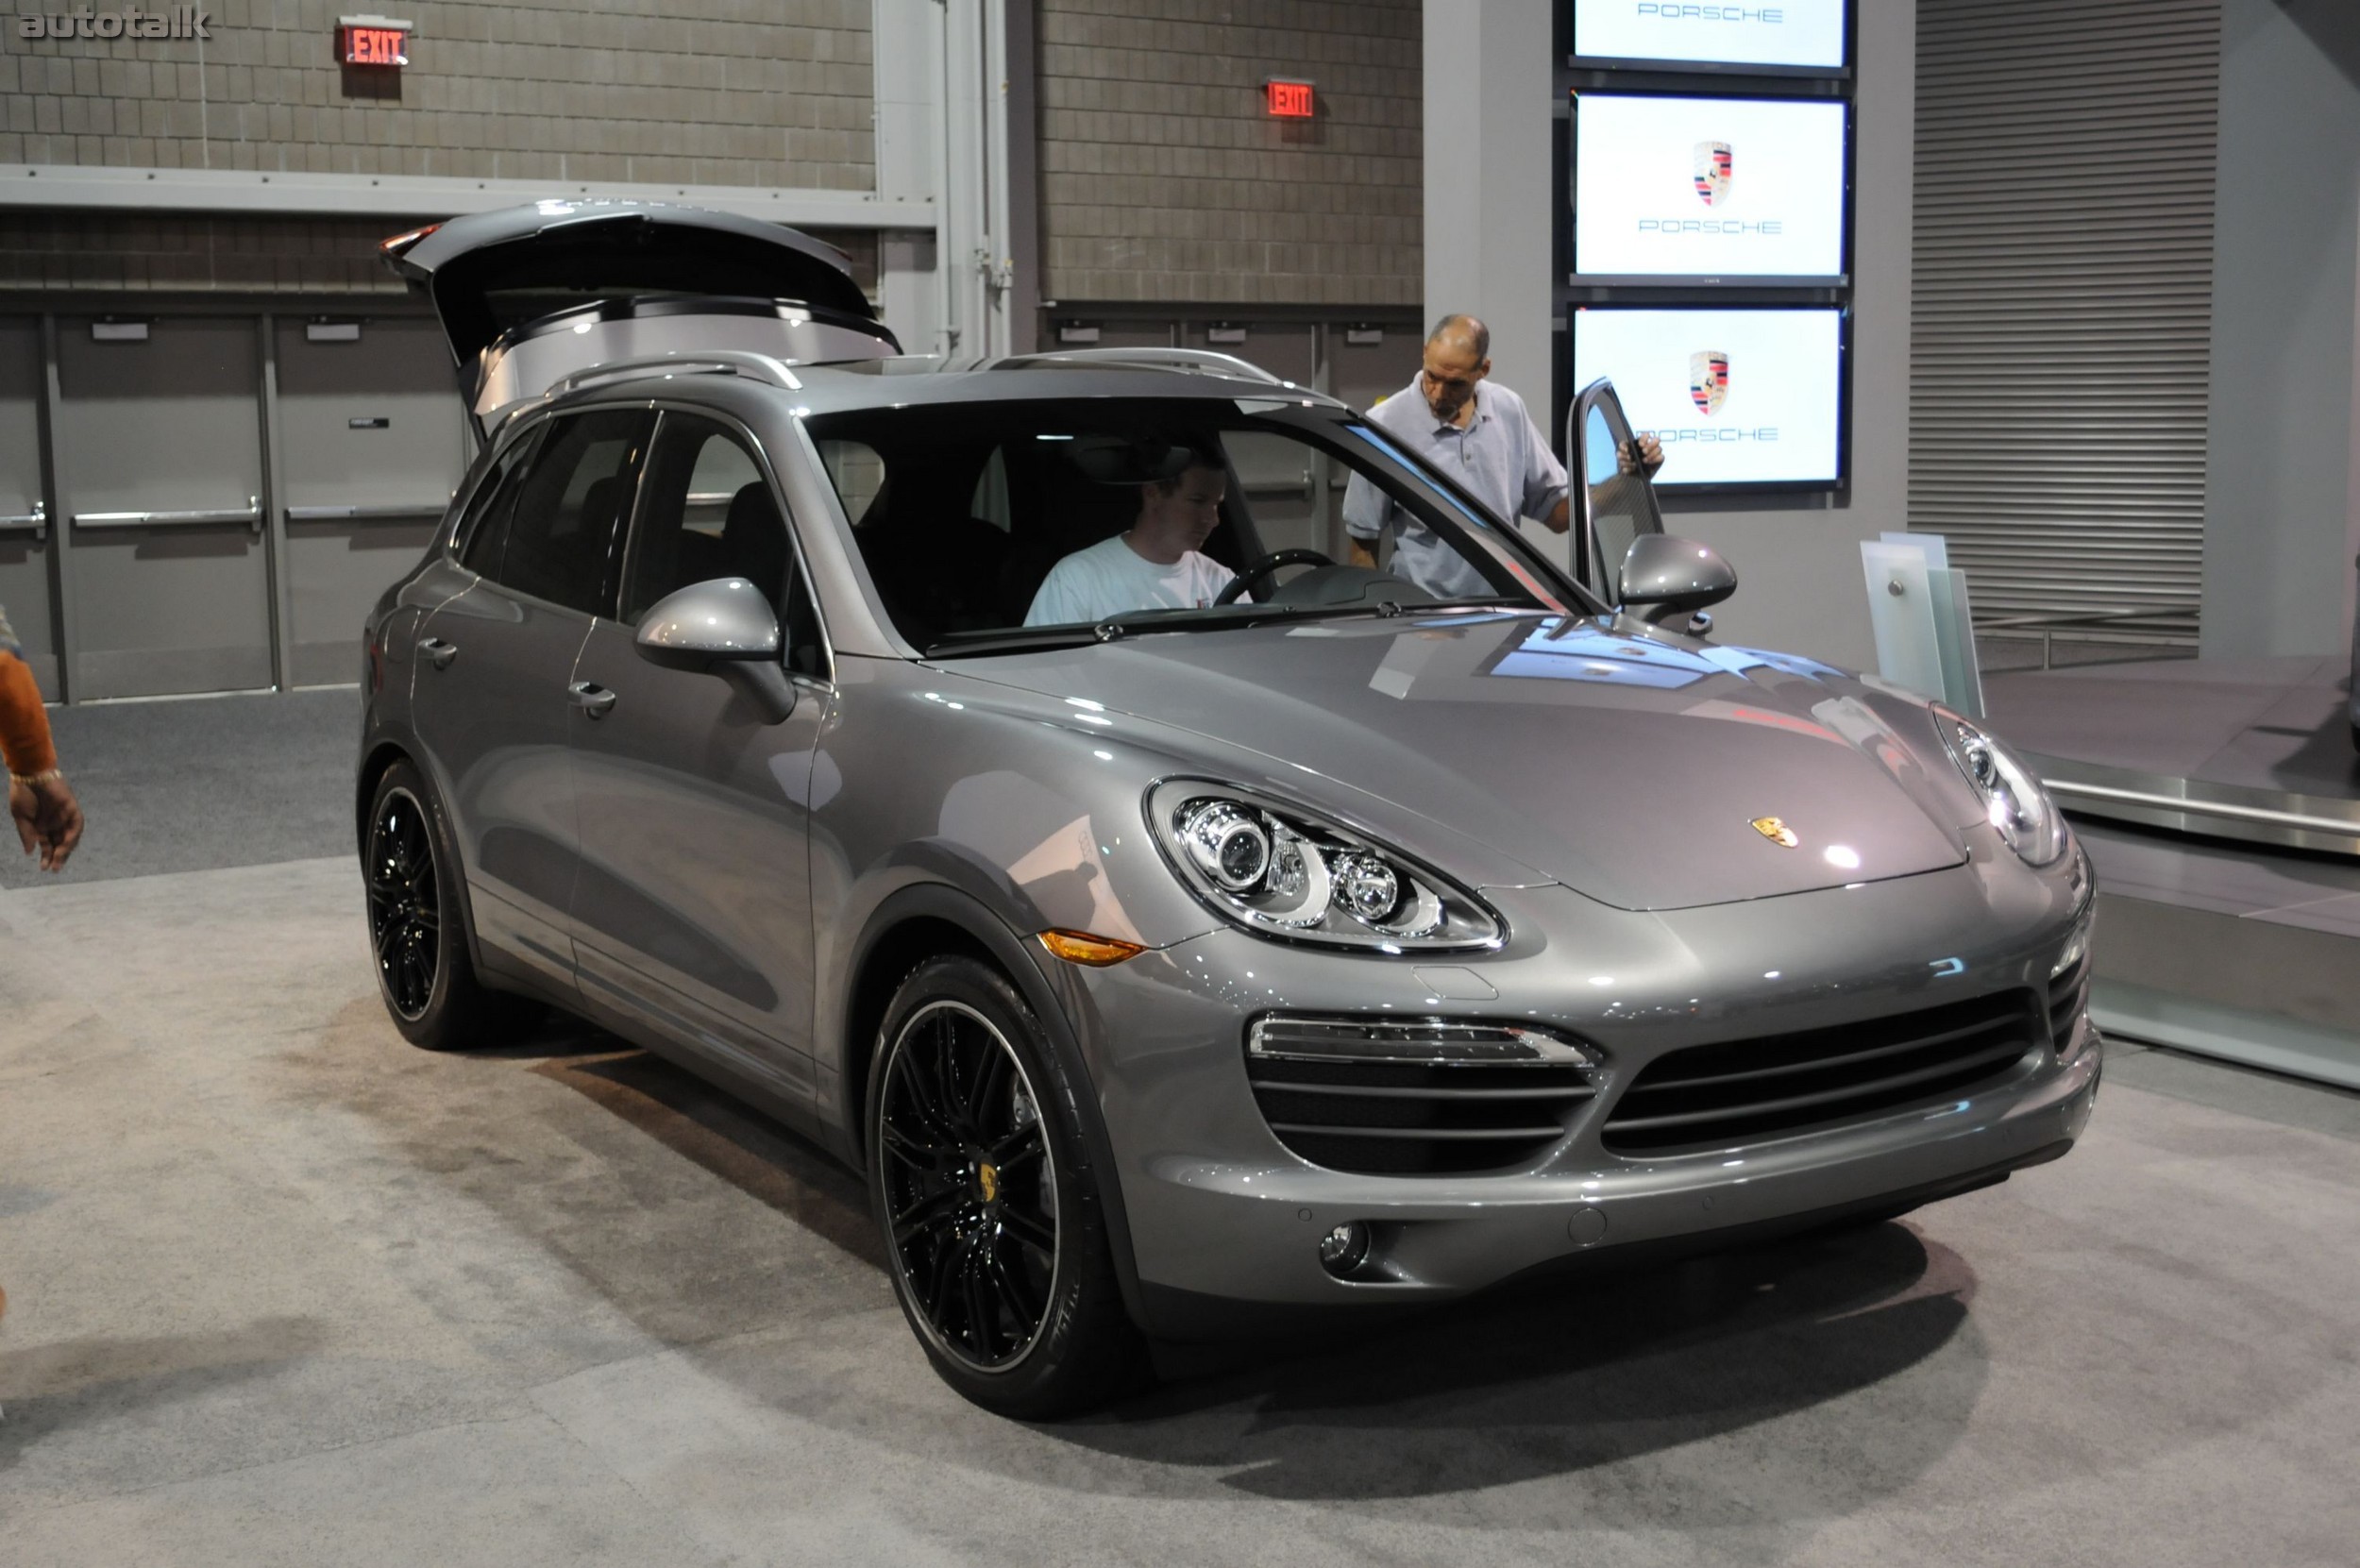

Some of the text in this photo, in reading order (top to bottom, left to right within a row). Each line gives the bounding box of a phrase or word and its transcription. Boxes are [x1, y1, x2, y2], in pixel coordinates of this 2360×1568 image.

[1638, 3, 1783, 23] PORSCHE
[353, 29, 403, 64] EXIT
[1273, 84, 1309, 114] EXIT
[1639, 219, 1782, 234] PORSCHE
